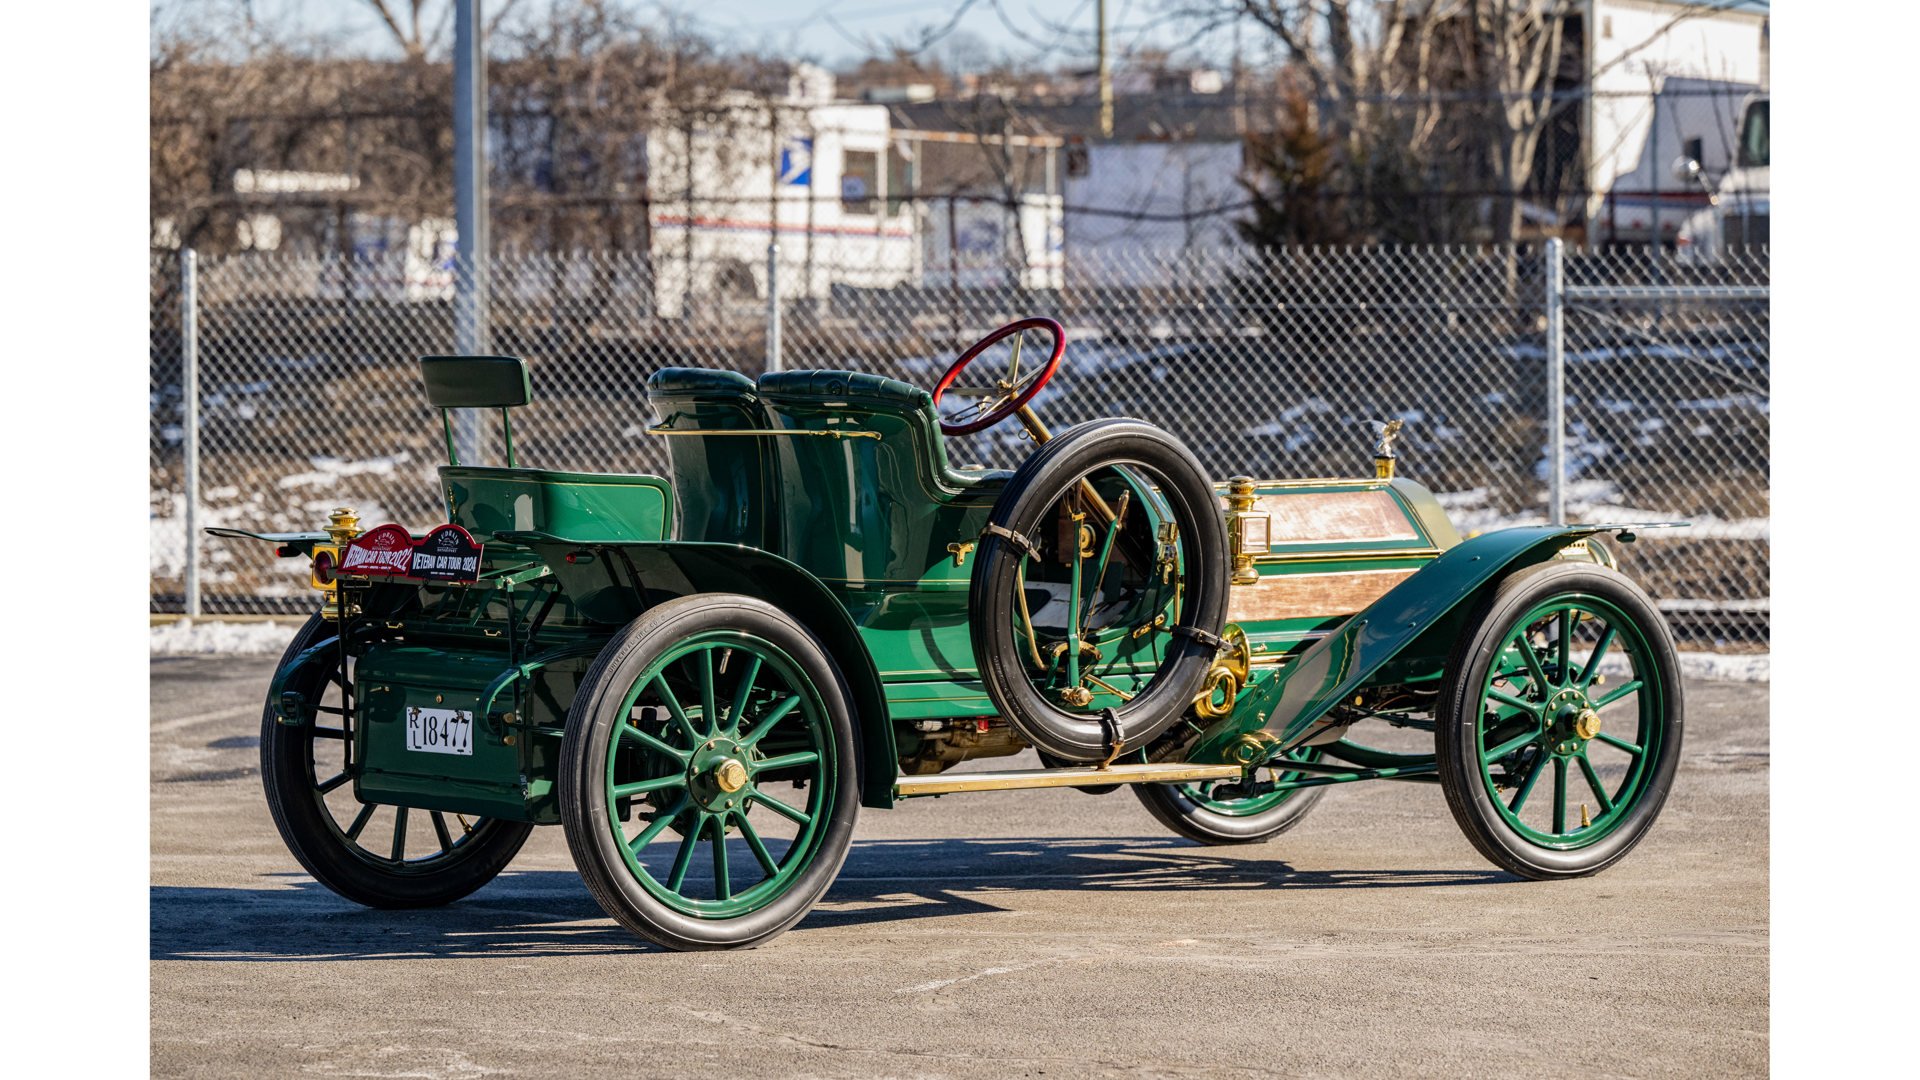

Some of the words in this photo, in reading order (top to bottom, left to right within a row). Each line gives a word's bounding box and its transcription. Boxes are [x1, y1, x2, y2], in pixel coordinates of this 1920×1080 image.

[366, 550, 379, 564] CAR
[376, 550, 393, 564] TOUR
[389, 547, 413, 572] 2022
[412, 552, 437, 570] VETERAN
[436, 555, 448, 569] CAR
[447, 556, 462, 570] TOUR
[462, 556, 478, 573] 2024
[423, 716, 470, 748] 18477
